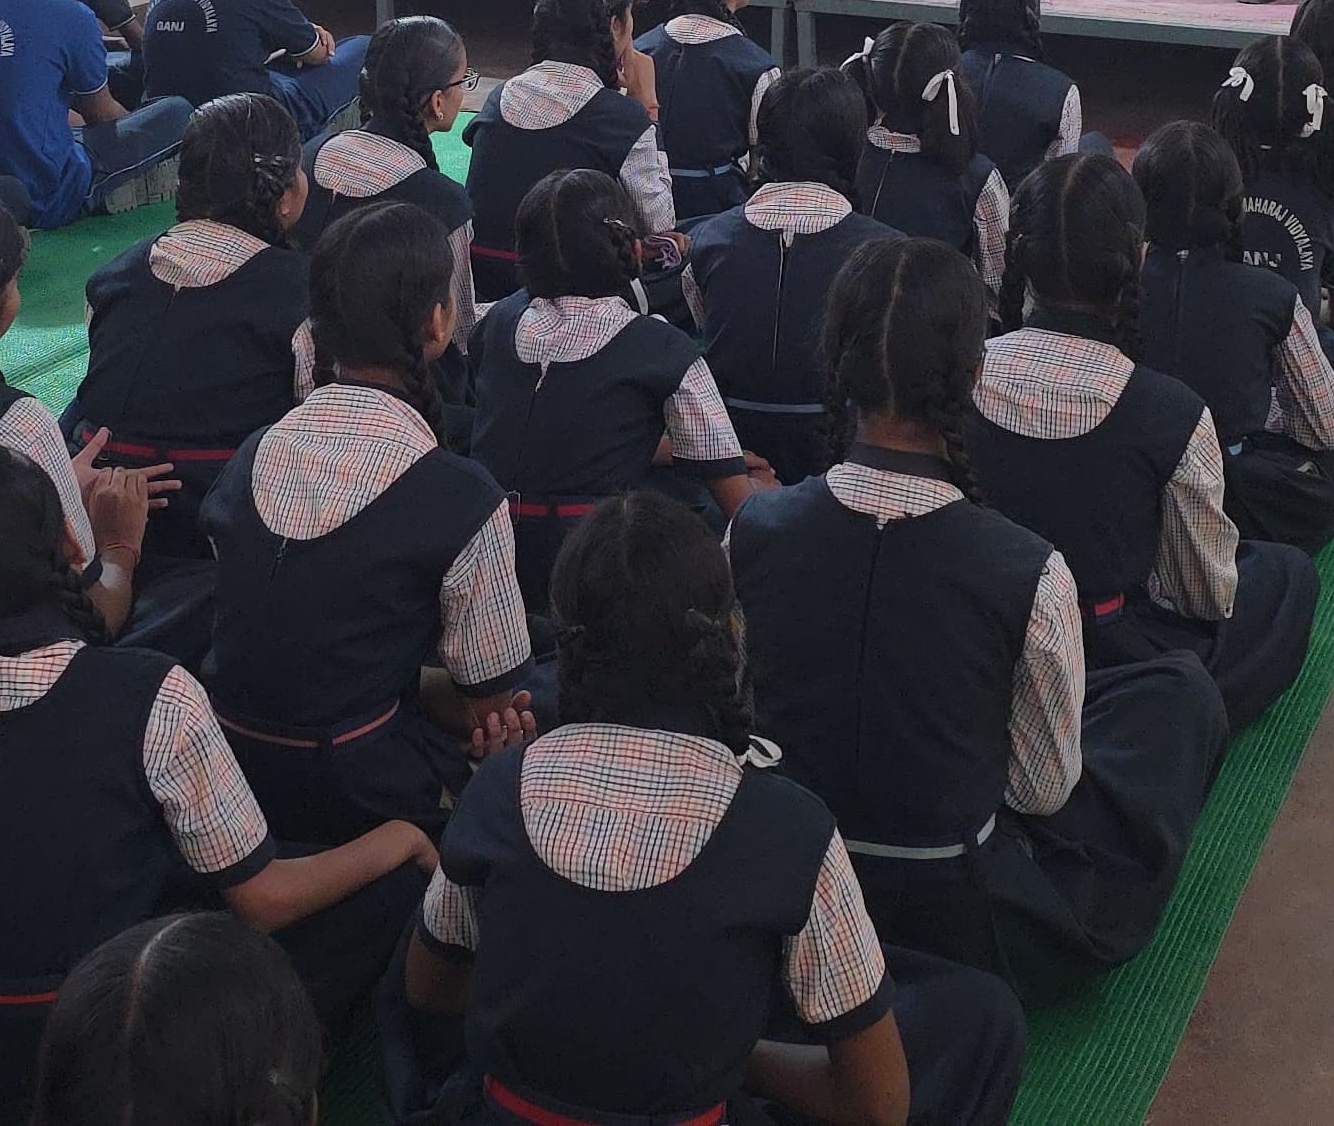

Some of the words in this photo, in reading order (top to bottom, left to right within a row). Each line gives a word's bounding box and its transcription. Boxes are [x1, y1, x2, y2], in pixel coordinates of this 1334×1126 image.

[157, 21, 185, 32] GANJ
[1284, 213, 1314, 271] VIDYALAYA
[1243, 250, 1282, 268] ANJ
